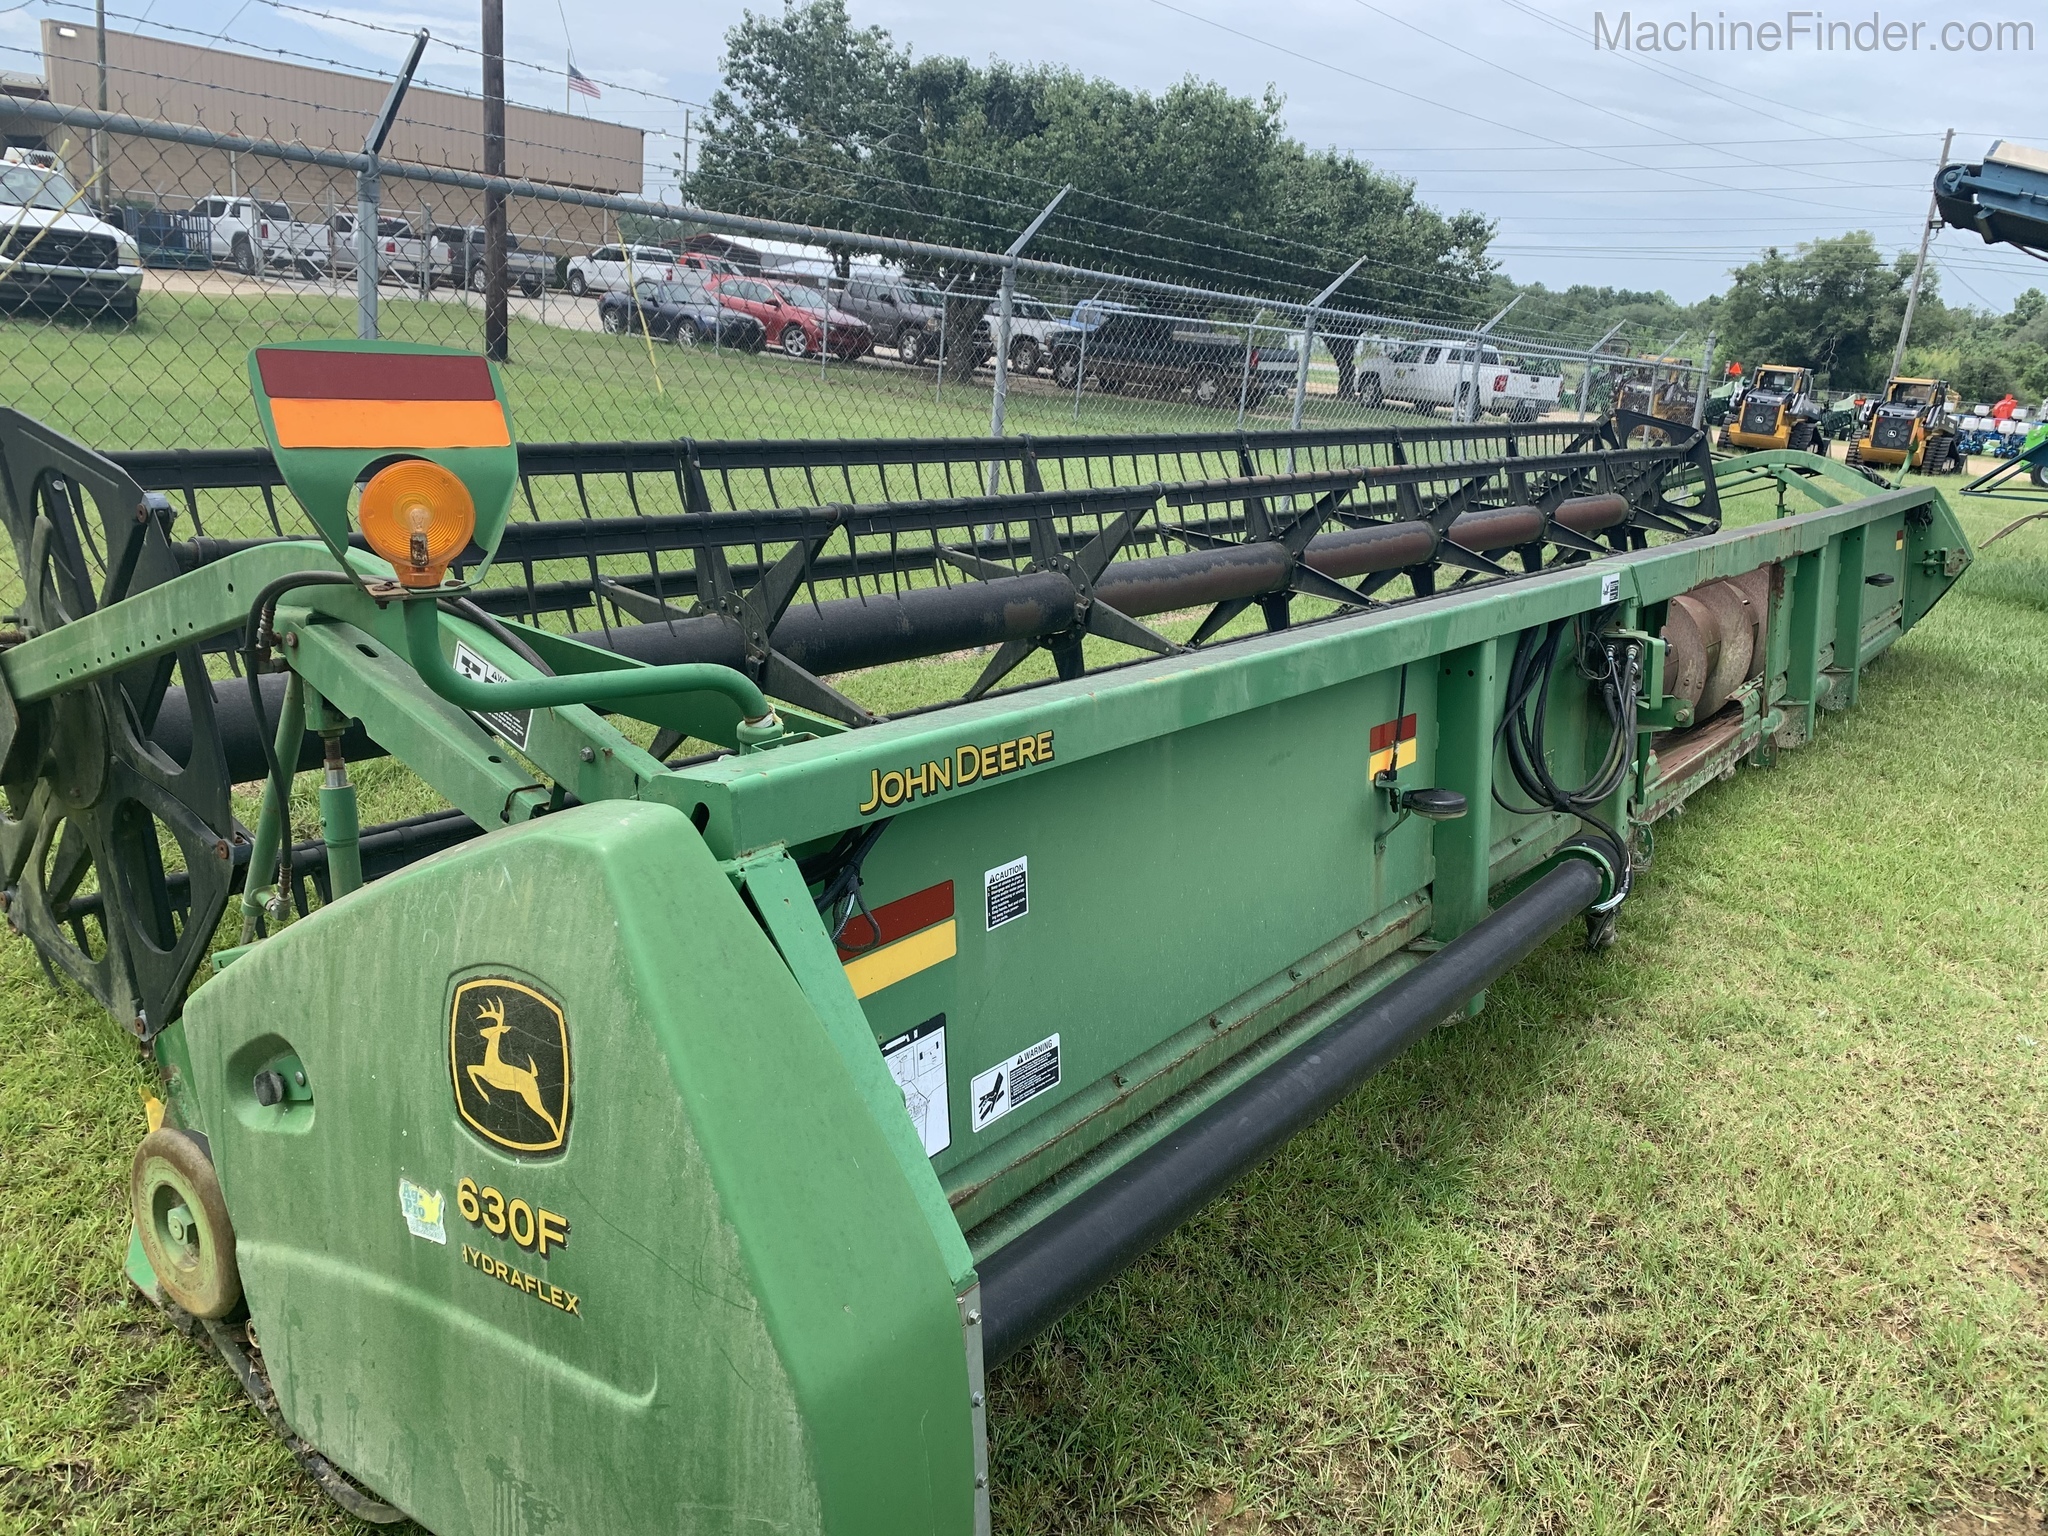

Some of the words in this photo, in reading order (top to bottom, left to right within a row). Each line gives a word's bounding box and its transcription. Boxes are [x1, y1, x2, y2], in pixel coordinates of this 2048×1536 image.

[859, 757, 952, 815] JOHN
[956, 730, 1054, 786] DEERE
[995, 863, 1024, 882] CAUTION
[1024, 1039, 1053, 1060] WARNING
[457, 1176, 570, 1258] 630F
